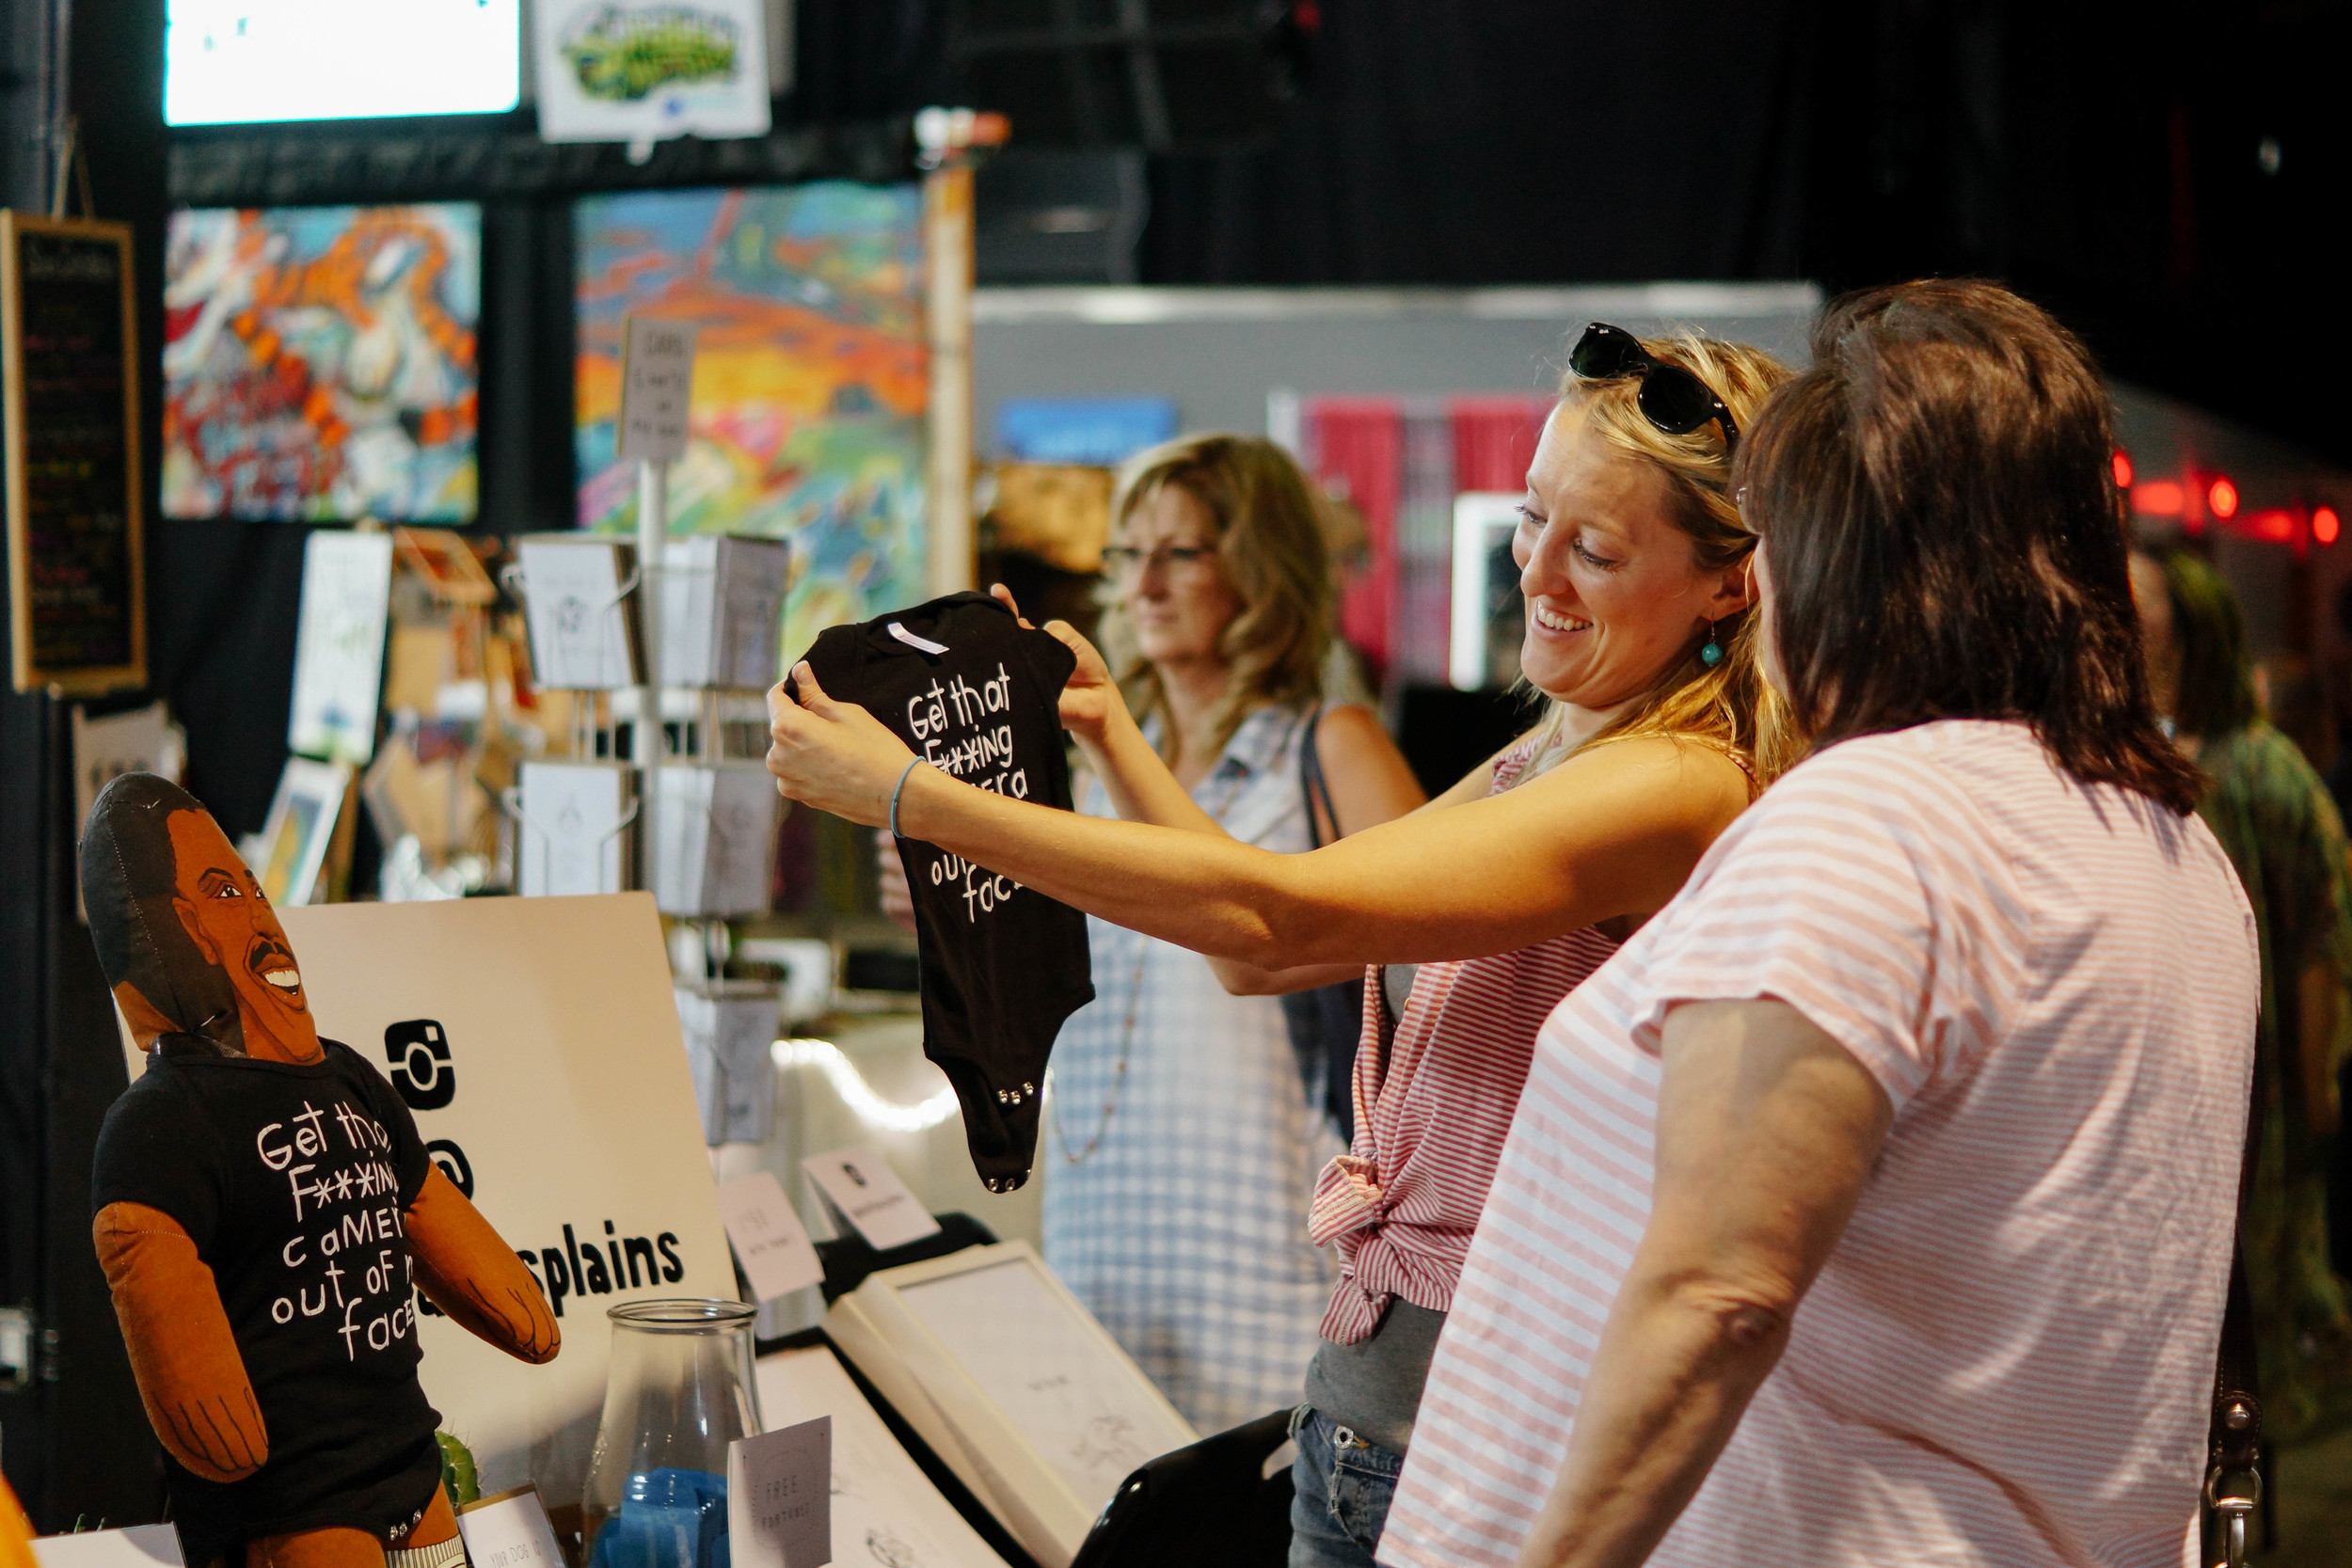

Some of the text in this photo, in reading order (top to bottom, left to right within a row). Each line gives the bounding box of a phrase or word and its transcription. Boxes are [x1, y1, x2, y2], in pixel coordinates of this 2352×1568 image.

[908, 662, 1010, 739] Get that
[962, 863, 1024, 924] fac
[257, 1101, 391, 1170] Get tha
[272, 1259, 344, 1323] out
[509, 1544, 530, 1563] DOG
